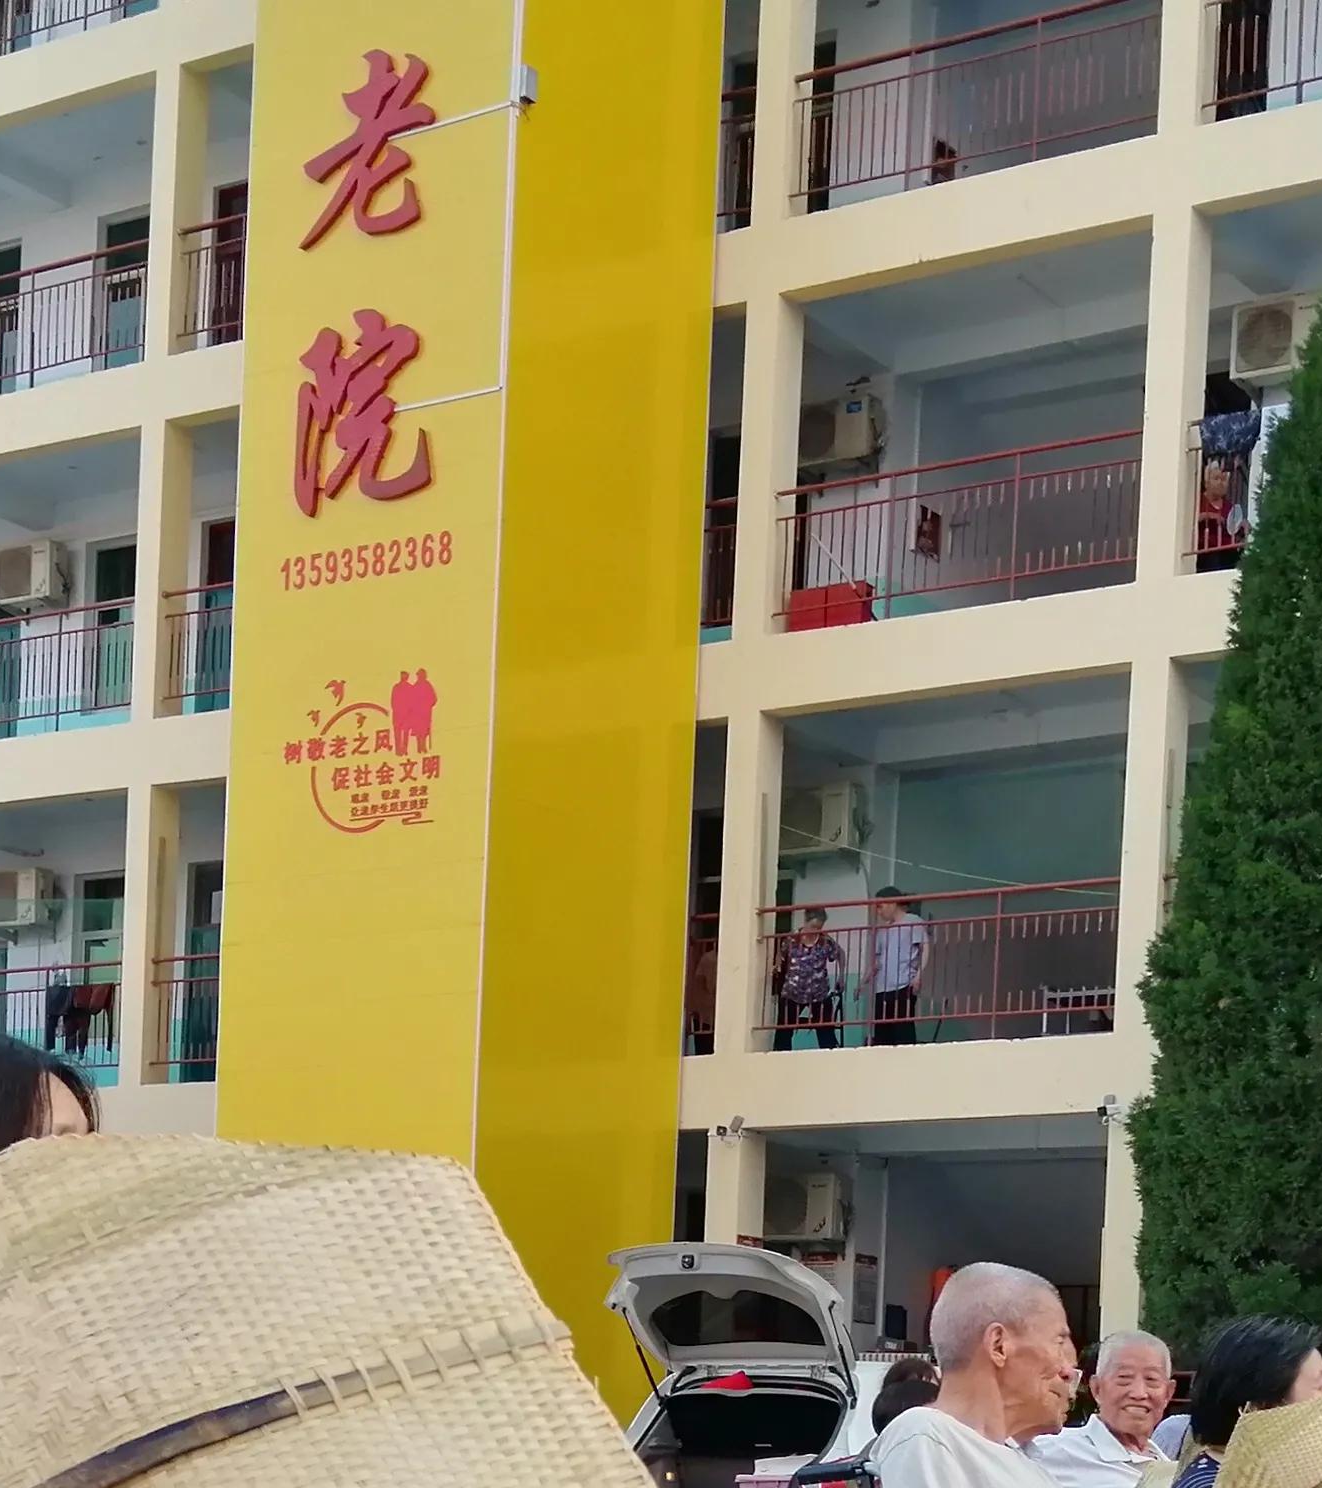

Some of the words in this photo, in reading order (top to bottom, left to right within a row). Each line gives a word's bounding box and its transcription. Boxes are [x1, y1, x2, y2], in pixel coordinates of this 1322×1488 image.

[279, 530, 453, 591] 13593582368
[283, 728, 394, 765] 树敬老之风
[331, 755, 441, 791] 促社会文明
